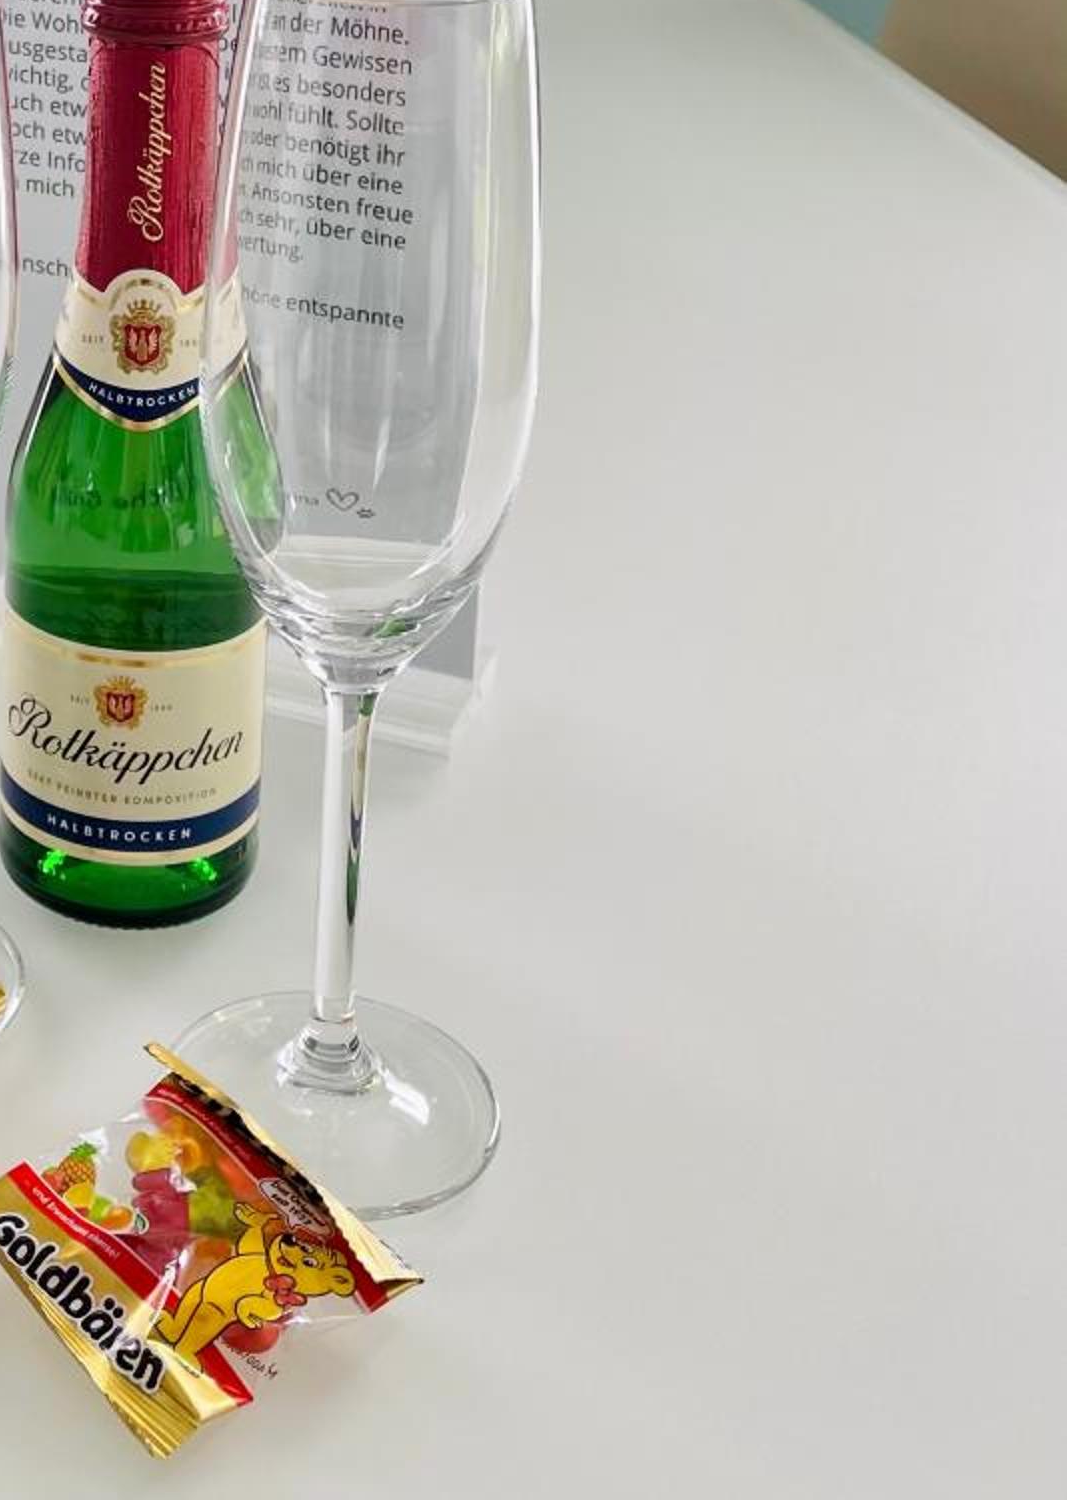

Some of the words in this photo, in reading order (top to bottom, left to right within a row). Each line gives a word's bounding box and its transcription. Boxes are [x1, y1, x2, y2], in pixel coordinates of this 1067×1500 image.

[32, 11, 83, 34] Woh
[291, 12, 322, 33] der
[331, 16, 409, 46] Möhne.
[9, 40, 88, 63] usgesta
[313, 45, 412, 75] Gewissen
[297, 73, 405, 107] besonders
[50, 99, 87, 117] etw
[288, 102, 338, 128] fühlt.
[346, 109, 405, 136] Sollte
[12, 120, 45, 140] och
[52, 126, 87, 145] etw
[285, 132, 370, 166] benötigt
[376, 143, 405, 166] ihr
[128, 61, 172, 242] Rotkäppchen
[48, 151, 85, 173] Info
[258, 158, 297, 179] mich
[303, 164, 352, 186] über
[358, 172, 402, 195] eine
[26, 178, 74, 198] mich
[252, 182, 349, 214] Ansonsten
[357, 197, 413, 224] freue
[306, 217, 356, 241] über
[361, 227, 406, 250] eine
[286, 297, 404, 330] entspannte
[88, 381, 196, 407] HALBTROCKEN
[9, 692, 244, 785] Rotkäppchen
[47, 813, 192, 843] HALBTROCKEN
